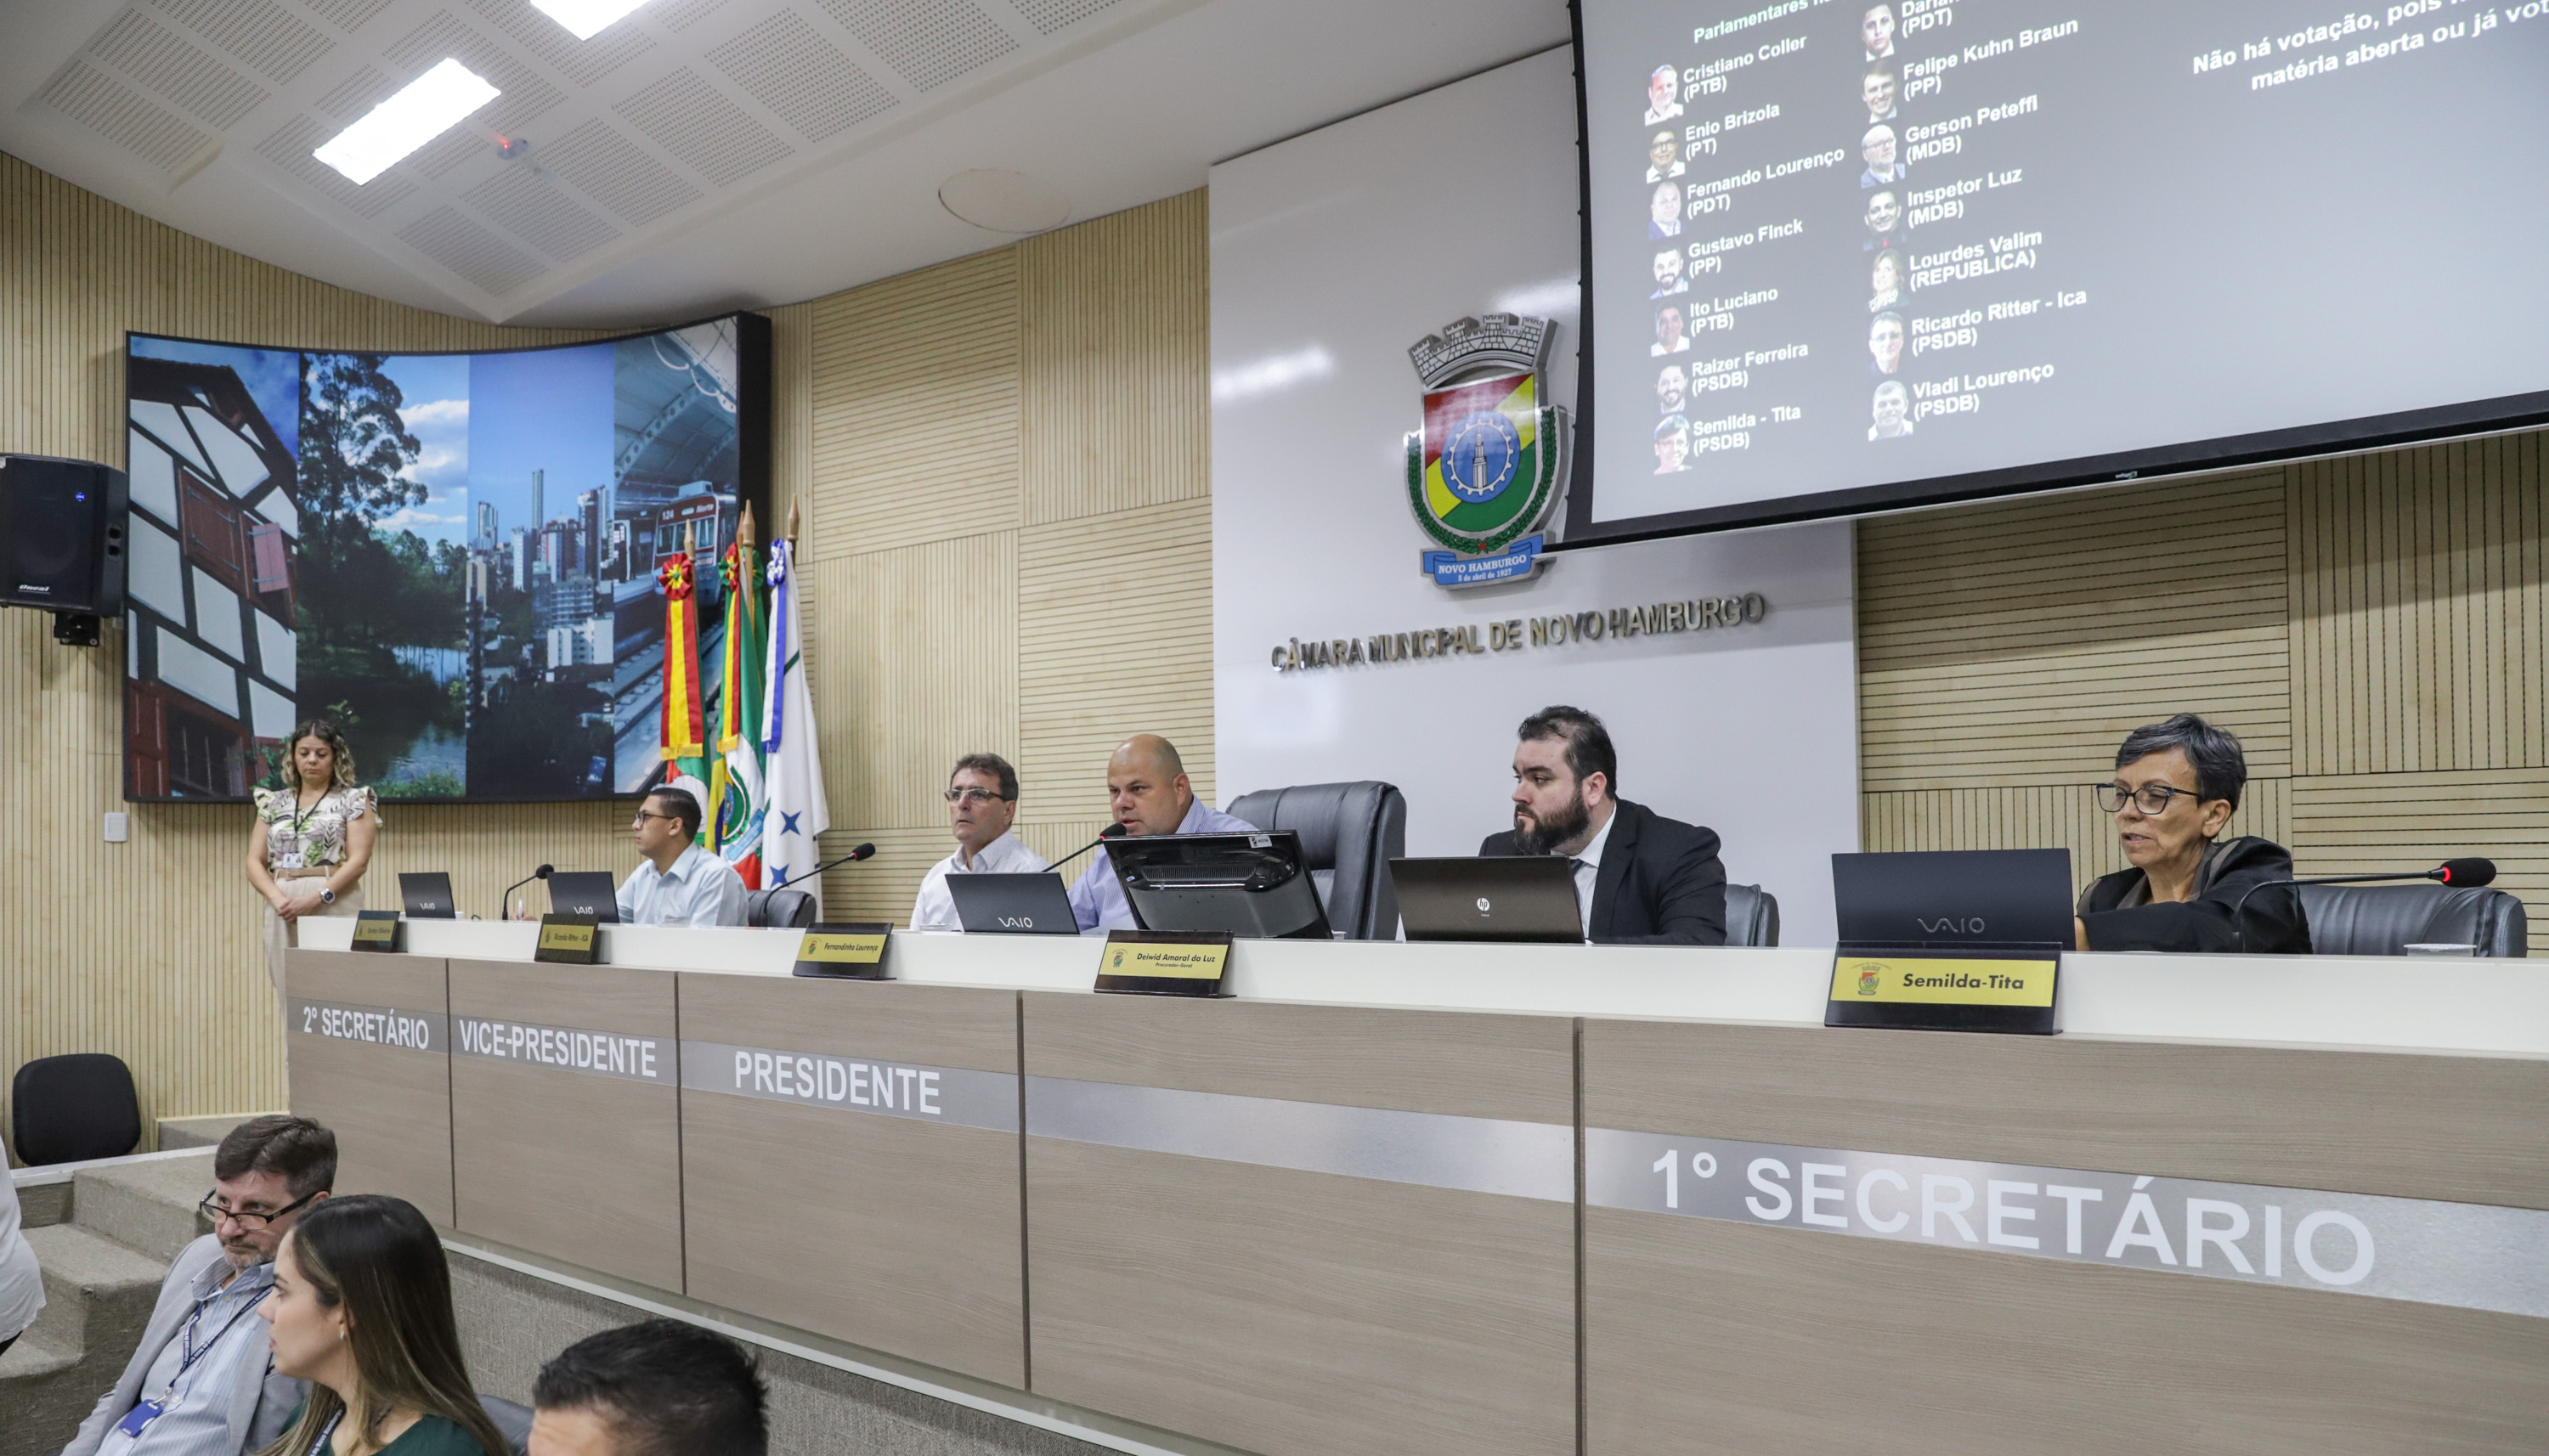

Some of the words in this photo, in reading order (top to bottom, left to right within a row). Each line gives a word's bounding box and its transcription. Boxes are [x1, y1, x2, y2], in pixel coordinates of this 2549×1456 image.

[1694, 0, 1809, 43] Parlamentares
[1902, 7, 1953, 37] (PDT)
[1903, 53, 1958, 83] Felipe
[1963, 36, 2015, 65] Kuhn
[2019, 20, 2079, 48] Braun
[2193, 48, 2236, 75] Não
[2243, 37, 2271, 61] há
[2277, 14, 2380, 50] votação,
[2388, 0, 2443, 27] pois
[2251, 54, 2338, 91] matéria
[2345, 32, 2425, 67] aberta
[2432, 21, 2465, 43] ou
[2471, 7, 2498, 38] já
[1683, 53, 1755, 83] Cristiano
[1757, 36, 1807, 61] Coller
[1683, 76, 1728, 104] (PTB)
[1903, 76, 1942, 103] (PP)
[1686, 121, 1721, 142] Enio
[1724, 104, 1780, 131] Brizola
[1905, 116, 1973, 144] Gerson
[1976, 94, 2038, 127] Peteffi
[1686, 138, 1717, 162] (PT)
[1906, 135, 1963, 166] (MDB)
[1687, 167, 1761, 200] Fernando
[1765, 148, 1845, 182] Lourenço
[1908, 178, 1982, 212] Inspetor
[1987, 168, 2023, 190] Luz
[1687, 194, 1731, 221] (PDT)
[1908, 200, 1964, 229] (MDB)
[1689, 232, 1755, 258] Gustavo
[1758, 219, 1804, 246] Finck
[1909, 242, 1985, 271] Lourdes
[1989, 230, 2043, 256] Valim
[1688, 256, 1722, 279] (PP)
[1910, 249, 2038, 292] (REPUBLICA)
[1690, 301, 1711, 318] Ito
[1714, 288, 1779, 314] Luciano
[1912, 308, 1983, 336] Ricardo
[1988, 297, 2041, 322] Ritter
[2058, 290, 2087, 308] Ica
[1690, 312, 1735, 338] (PTB)
[1912, 328, 1978, 357] (PSDB)
[1692, 357, 1742, 378] Raizer
[1744, 342, 1809, 367] Ferreira
[1692, 370, 1749, 398] (PSDB)
[1913, 375, 1958, 400] Vladi
[1964, 364, 2054, 391] Lourenço
[1693, 412, 1756, 437] Semilda
[1771, 404, 1802, 422] Tita
[1913, 395, 1981, 423] (PSDB)
[1693, 432, 1750, 457] (PSDB)
[1438, 564, 1467, 574] NOVO
[1468, 554, 1527, 573] HAMBURGO
[1472, 572, 1487, 581] abril
[1496, 568, 1512, 578] 1927
[1271, 636, 1367, 672] CÂMARA
[1368, 624, 1484, 663] MUNICIPAL
[1489, 618, 1522, 652] DE
[1530, 610, 1603, 646] NOVO
[1608, 592, 1766, 639] HAMBURGO
[419, 902, 436, 911] VAIO
[574, 906, 594, 915] VAIO
[1477, 897, 1490, 911] hp
[998, 917, 1033, 928] VAIO
[1917, 917, 1986, 934] VAIO
[824, 942, 855, 951] Fernandinho
[856, 943, 879, 953] Lourenço
[1137, 952, 1161, 961] Deiwid
[1902, 973, 2025, 990] Semilda-Tita
[321, 1008, 429, 1050] SECRETÁRIO
[460, 1019, 658, 1078] VICE-PRESIDENTE
[735, 1051, 942, 1115] PRESIDENTE
[1745, 1157, 2377, 1286] SECRETÁRIO
